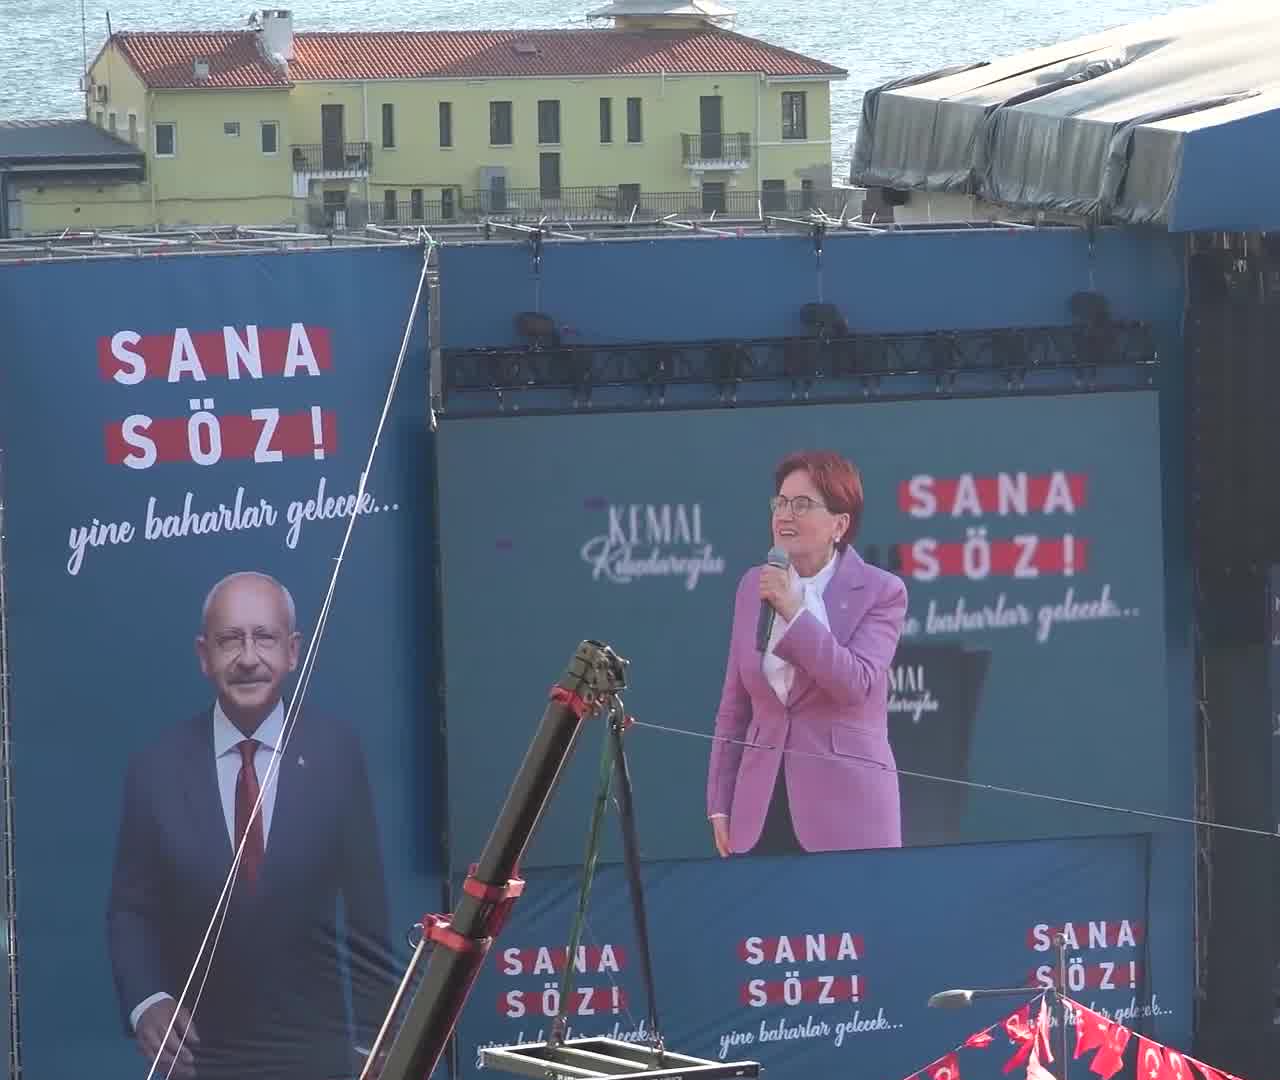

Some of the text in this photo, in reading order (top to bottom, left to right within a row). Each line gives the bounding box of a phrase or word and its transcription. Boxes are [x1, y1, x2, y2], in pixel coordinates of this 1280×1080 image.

[110, 322, 321, 386] SANA
[121, 399, 327, 470] SÖZ!
[908, 470, 1076, 518] SANA
[67, 472, 399, 576] yine baharlar gelecek...
[912, 528, 1076, 581] SÖZ!
[925, 594, 1031, 636] baharlar
[745, 932, 859, 965] SANA
[1033, 919, 1136, 952] SANA
[503, 944, 619, 975] SANA
[1036, 958, 1137, 991] SÖZ!
[506, 983, 619, 1018] SÖZ!
[748, 971, 859, 1007] SÖZ!
[719, 1008, 904, 1059] yine baharlar gelecek...
